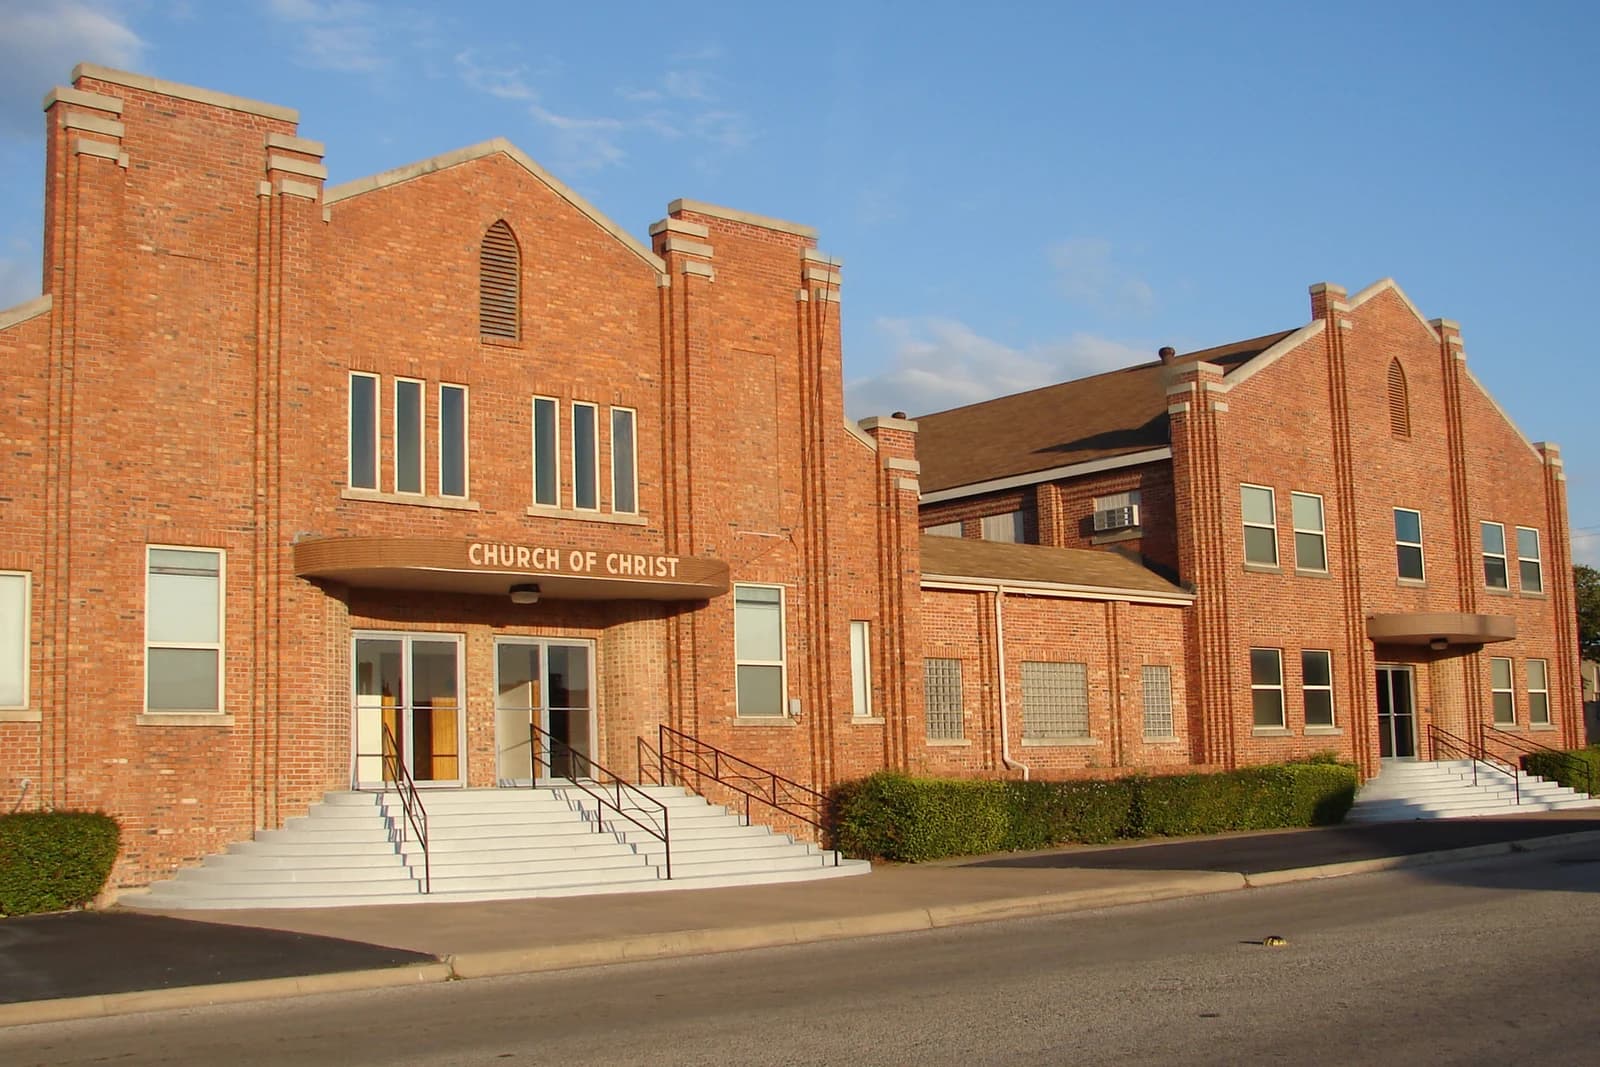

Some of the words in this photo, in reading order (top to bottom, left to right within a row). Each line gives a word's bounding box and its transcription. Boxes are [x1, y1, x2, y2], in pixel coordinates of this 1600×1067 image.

[468, 543, 560, 570] CHURCH
[569, 550, 597, 572] OF
[606, 553, 679, 577] CHRIST
